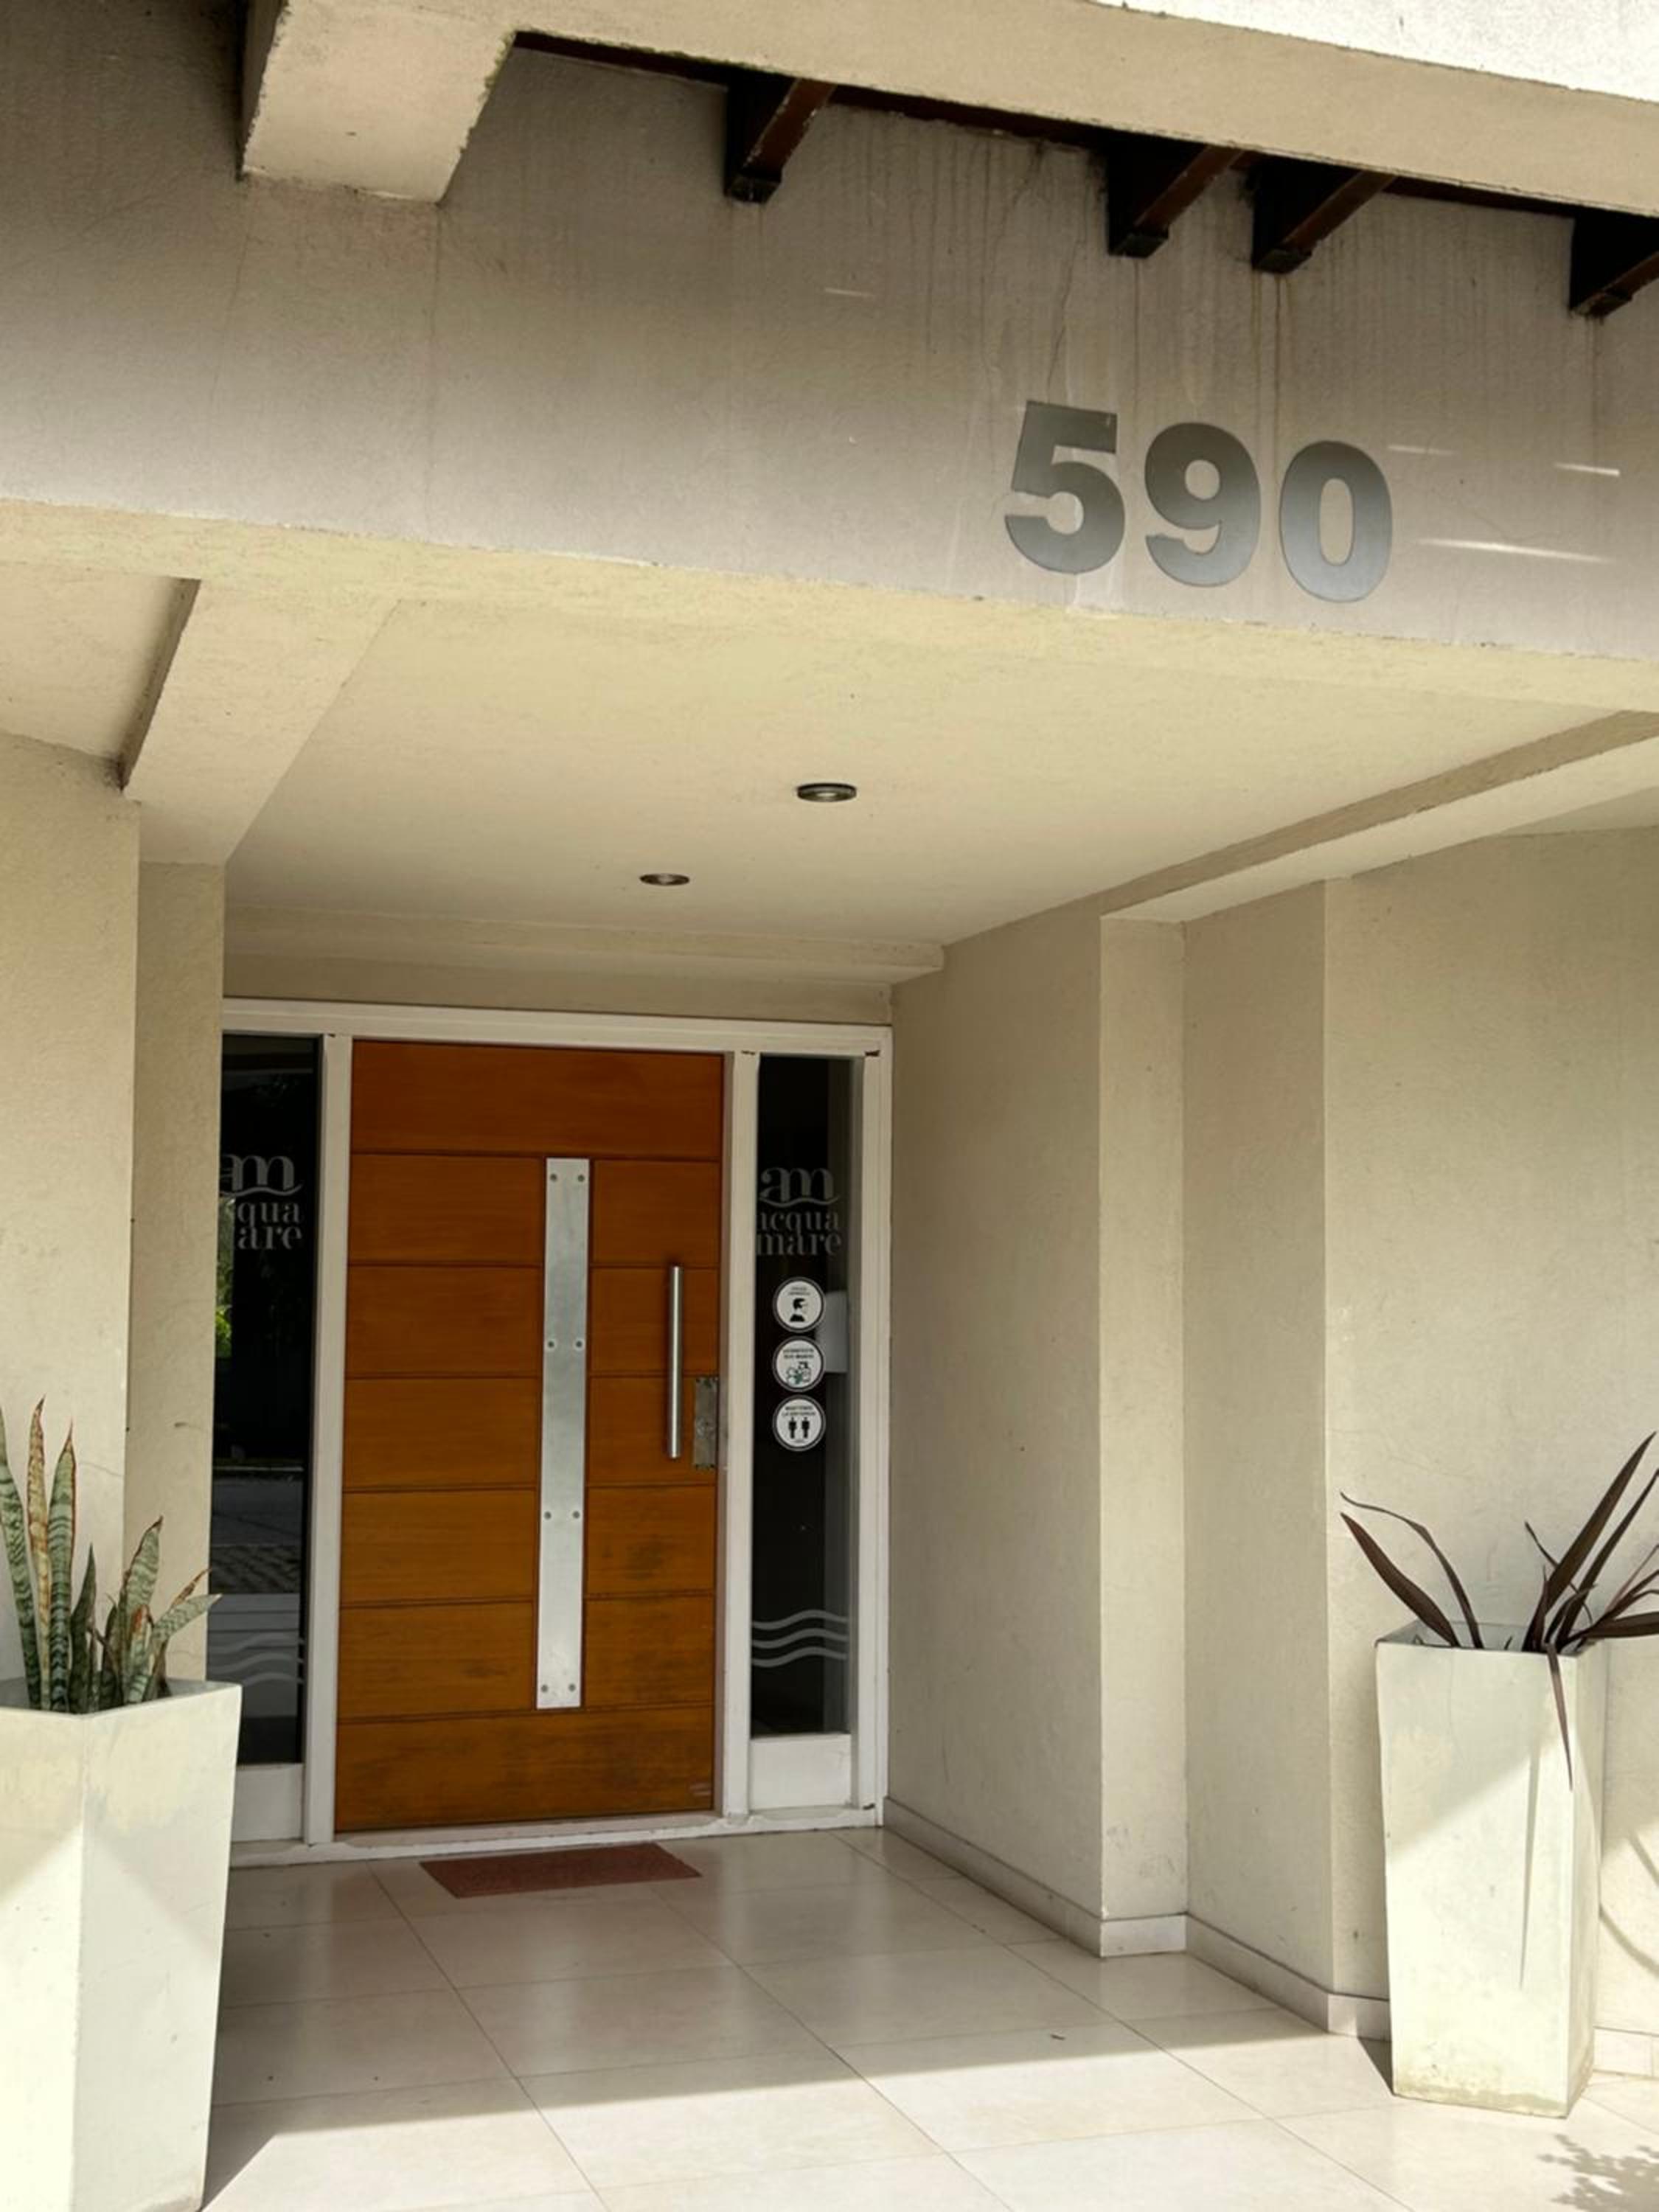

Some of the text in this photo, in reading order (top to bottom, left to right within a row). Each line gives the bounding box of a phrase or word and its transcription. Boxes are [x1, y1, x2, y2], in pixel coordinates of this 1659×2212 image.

[1004, 400, 1393, 603] 590
[237, 1202, 300, 1228] qua
[237, 1226, 302, 1250] are
